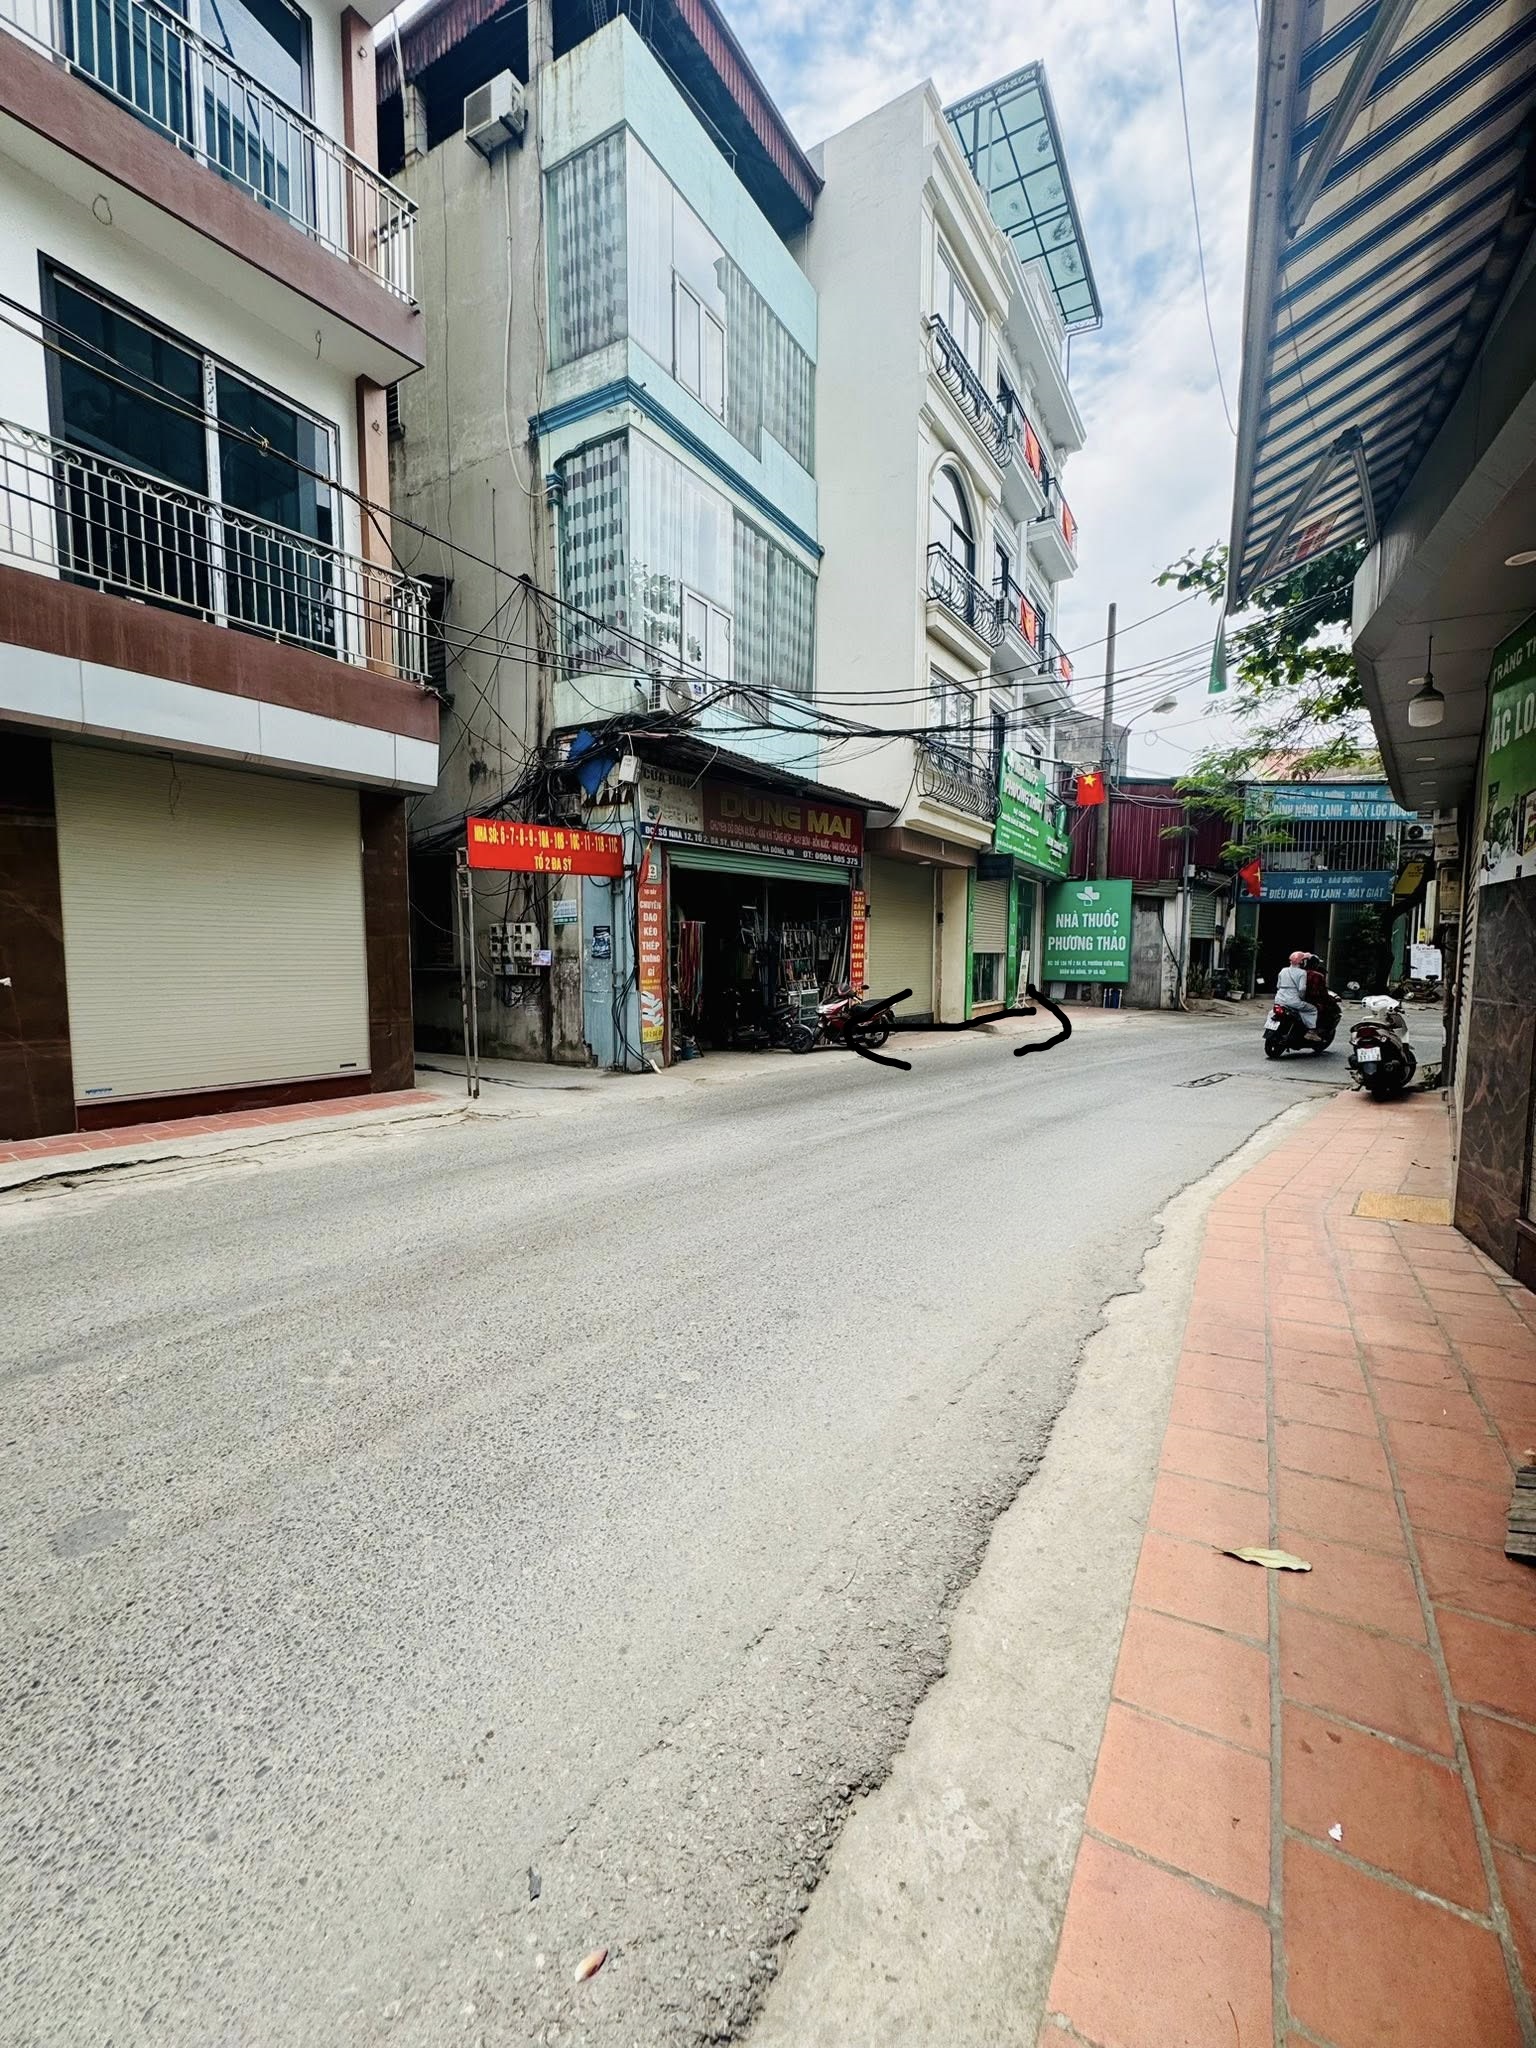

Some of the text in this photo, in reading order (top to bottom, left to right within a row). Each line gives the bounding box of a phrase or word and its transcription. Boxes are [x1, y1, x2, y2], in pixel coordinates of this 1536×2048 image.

[1295, 801, 1319, 817] NÓNG
[1320, 804, 1343, 819] LẠNH
[1371, 804, 1387, 819] LỌC
[807, 809, 851, 839] MAI
[510, 826, 515, 846] 7
[545, 856, 550, 870] 2
[1269, 886, 1384, 900] ĐIỀU HÒA TỦ LẠNH MÁY GIẶT
[643, 912, 657, 922] DAO
[1055, 907, 1119, 928] NHÀ THUỐC
[644, 925, 658, 936] KÉO
[641, 940, 660, 950] THÉP
[1048, 929, 1126, 951] PHƯƠNG THẢO
